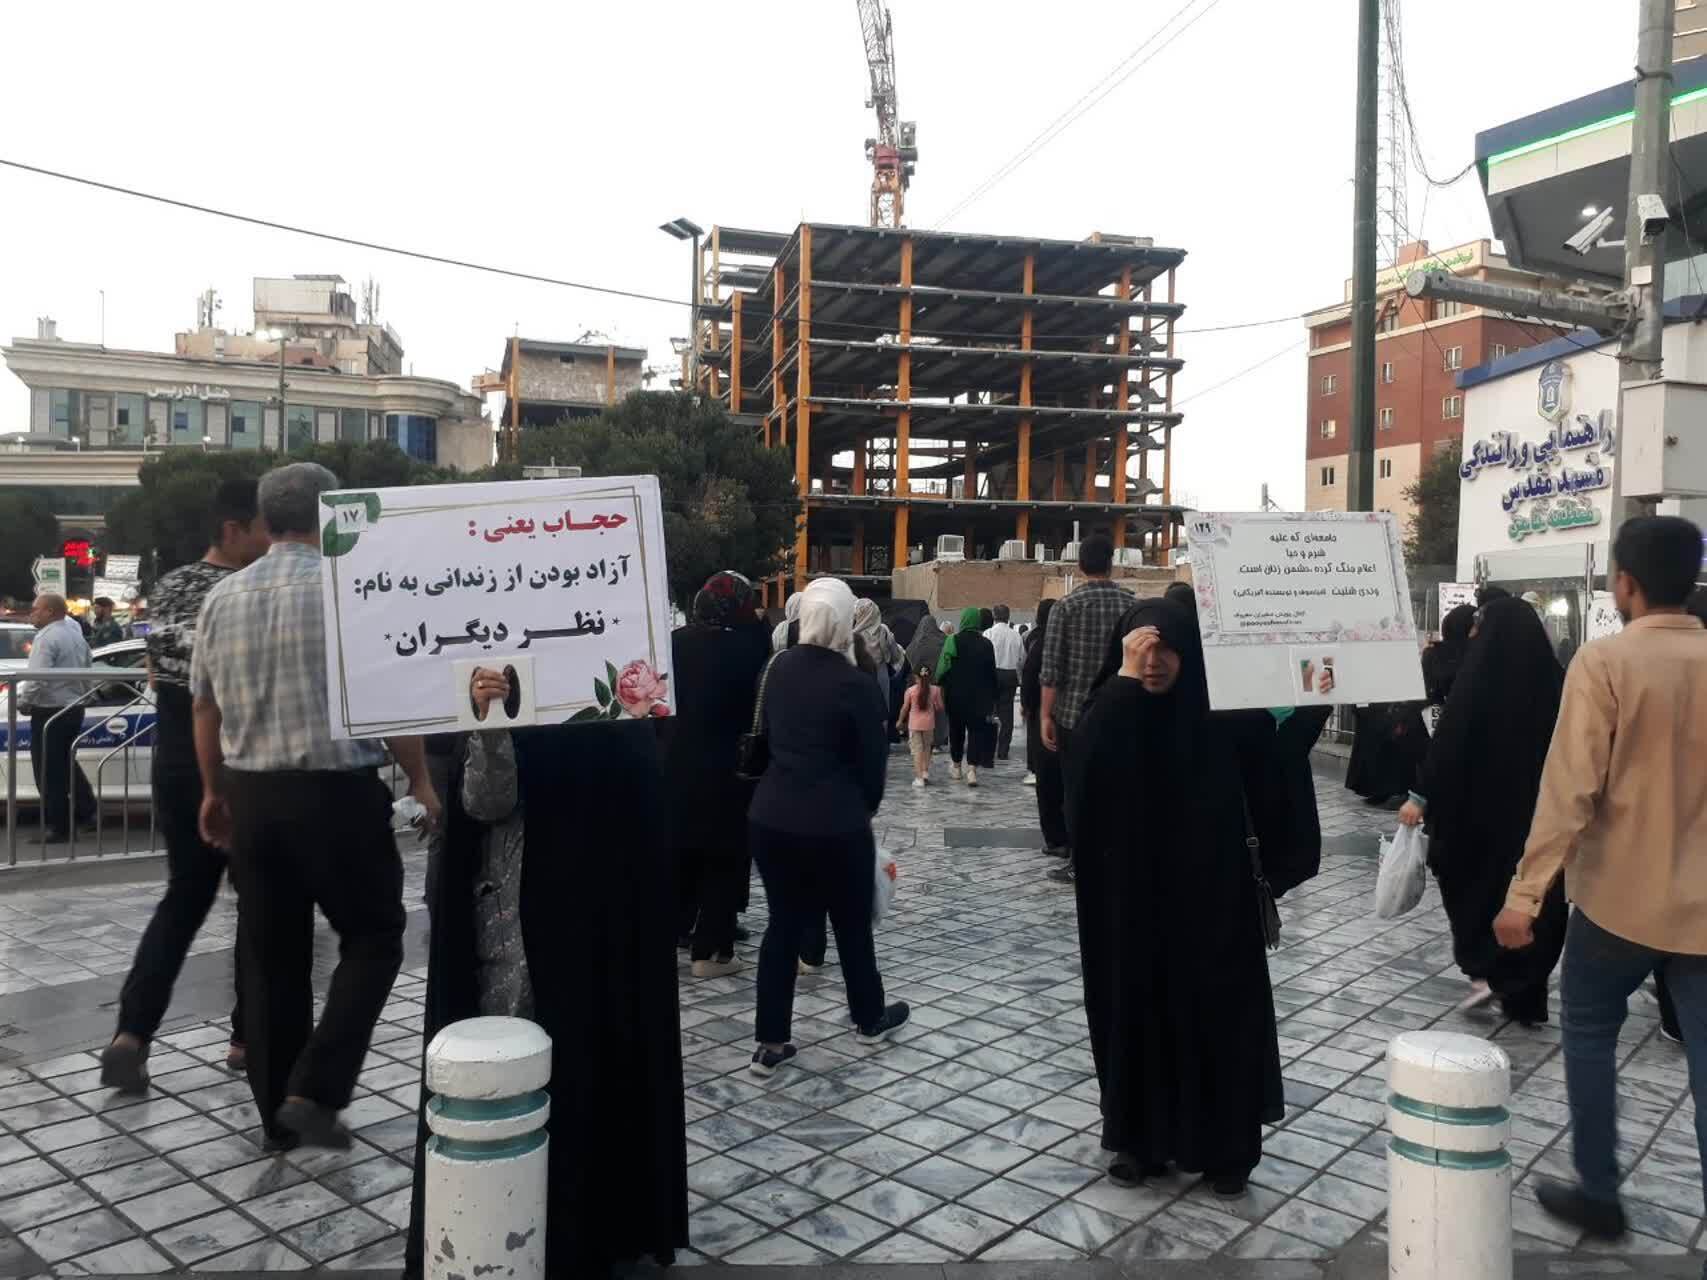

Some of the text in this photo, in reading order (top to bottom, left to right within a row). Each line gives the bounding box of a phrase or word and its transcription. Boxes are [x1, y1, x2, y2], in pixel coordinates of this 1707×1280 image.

[147, 384, 231, 400] هتل ادریس
[1533, 410, 1615, 464] راهنمایی
[1502, 465, 1552, 512] مقدس
[343, 509, 358, 522] ۱۷
[1269, 532, 1288, 543] علیه
[1290, 531, 1300, 542] که
[1307, 549, 1326, 558] شرم
[1239, 564, 1262, 573] است
[1264, 564, 1281, 574] زنان
[1314, 562, 1332, 574] کرده
[1335, 562, 1356, 573] جنگ
[1356, 563, 1376, 574] اعلام
[354, 554, 631, 600] آزاد بودن از زندانی به نام:
